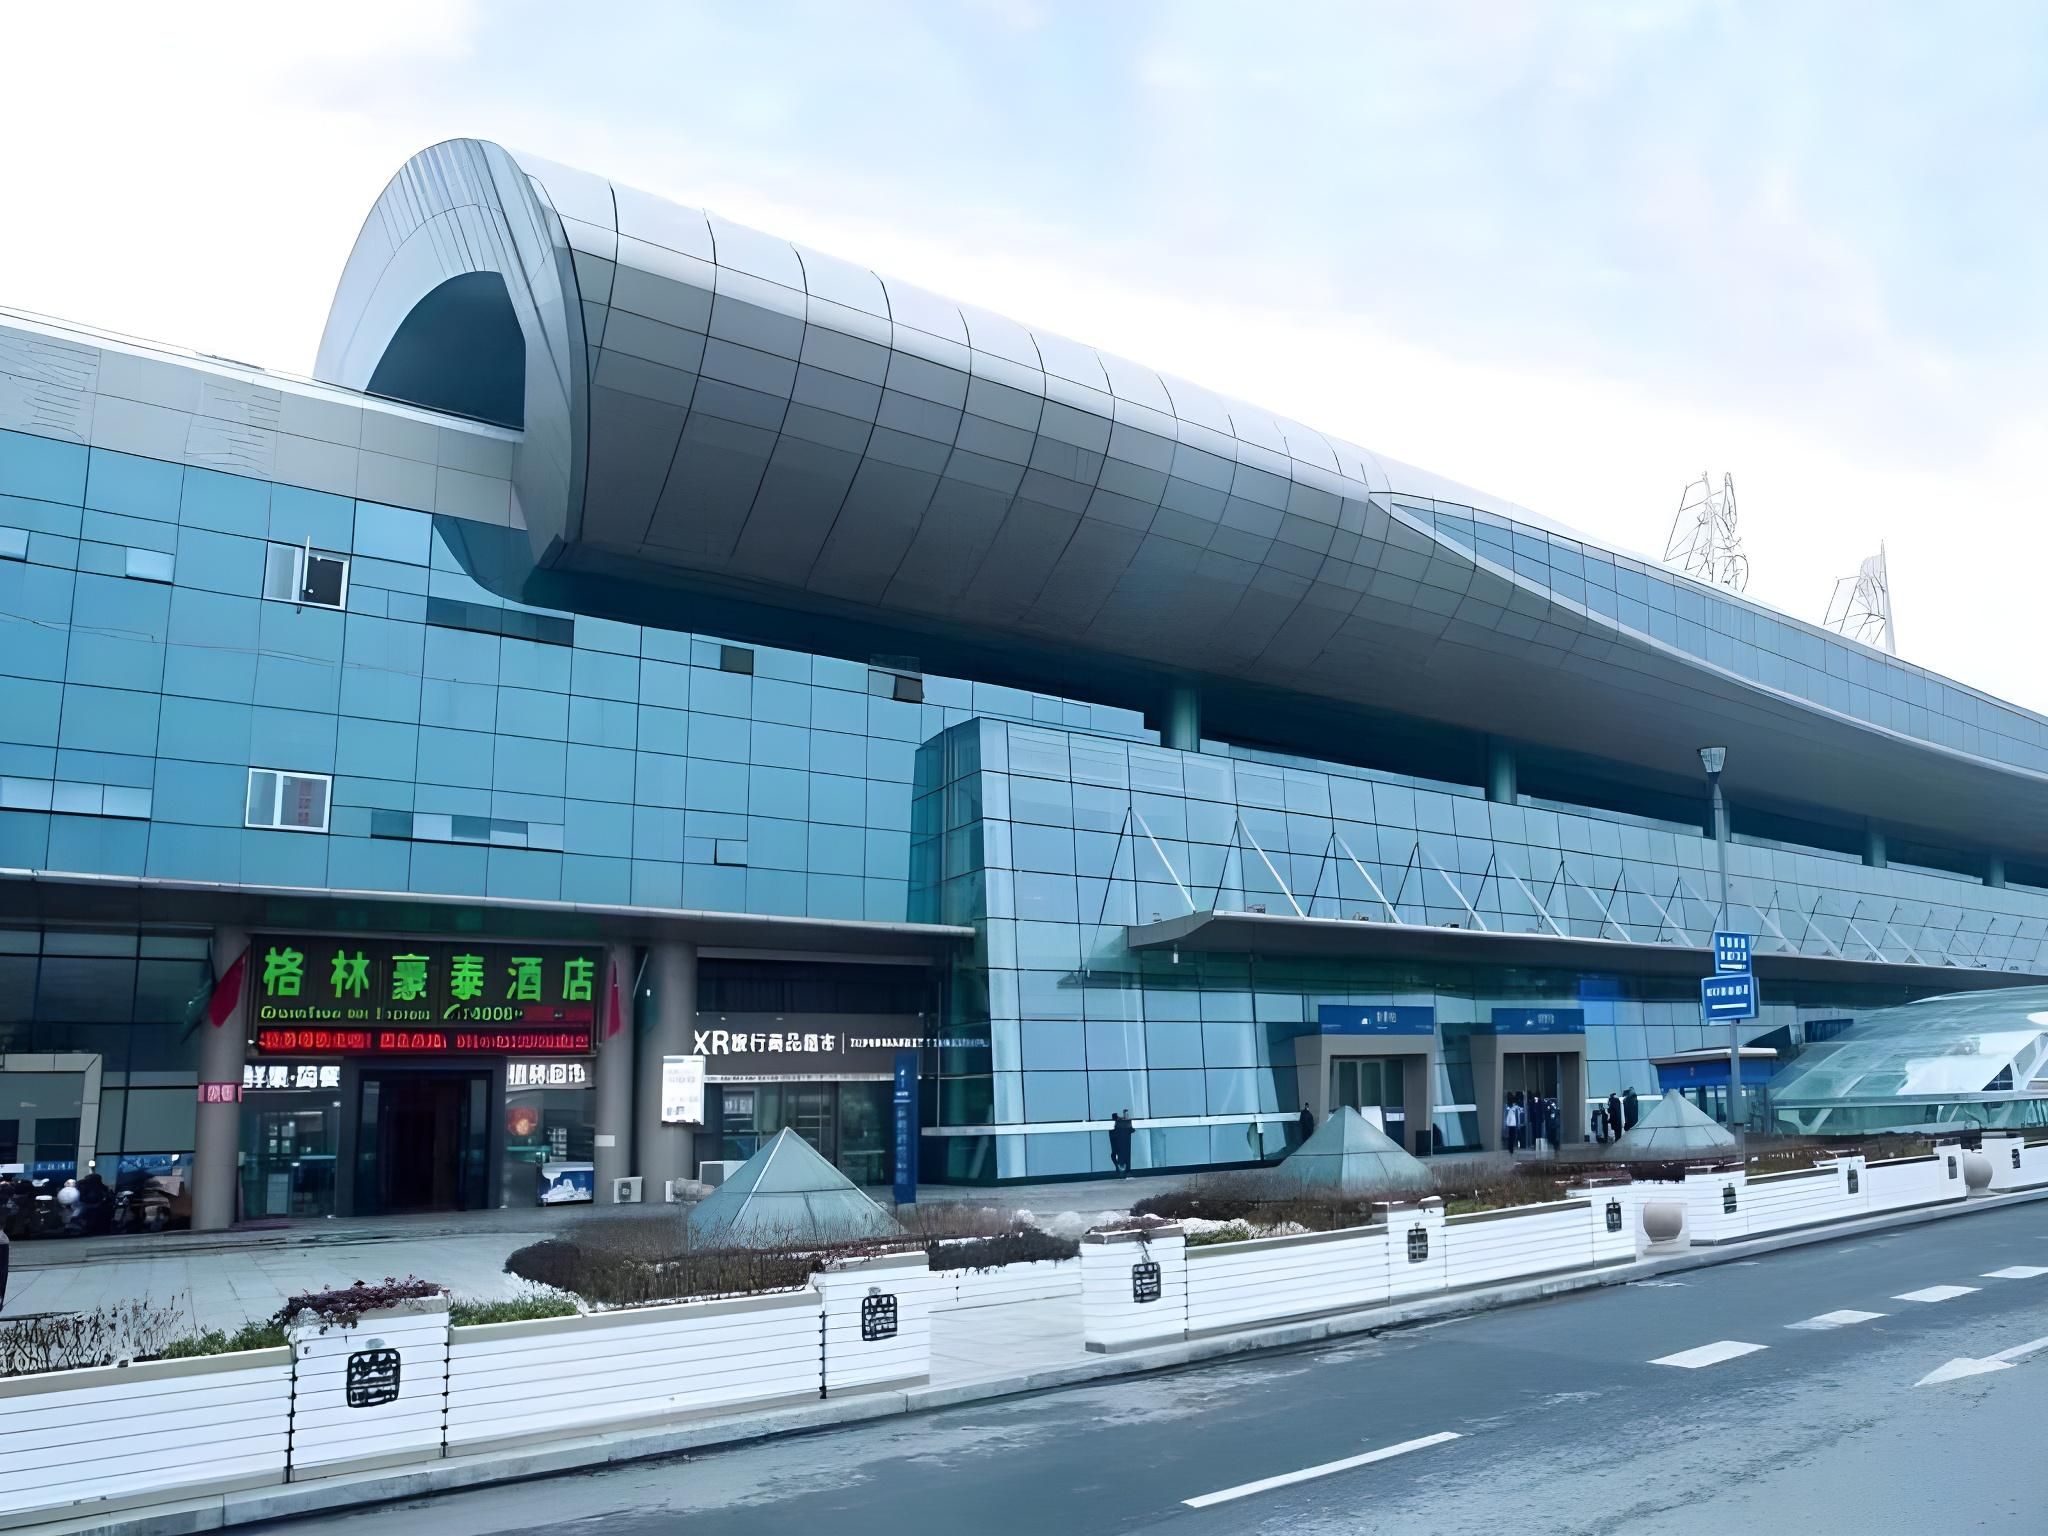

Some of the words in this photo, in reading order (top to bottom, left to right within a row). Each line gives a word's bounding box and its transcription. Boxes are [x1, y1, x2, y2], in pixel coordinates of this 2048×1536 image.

[263, 947, 594, 1001] 格林豪泰酒店
